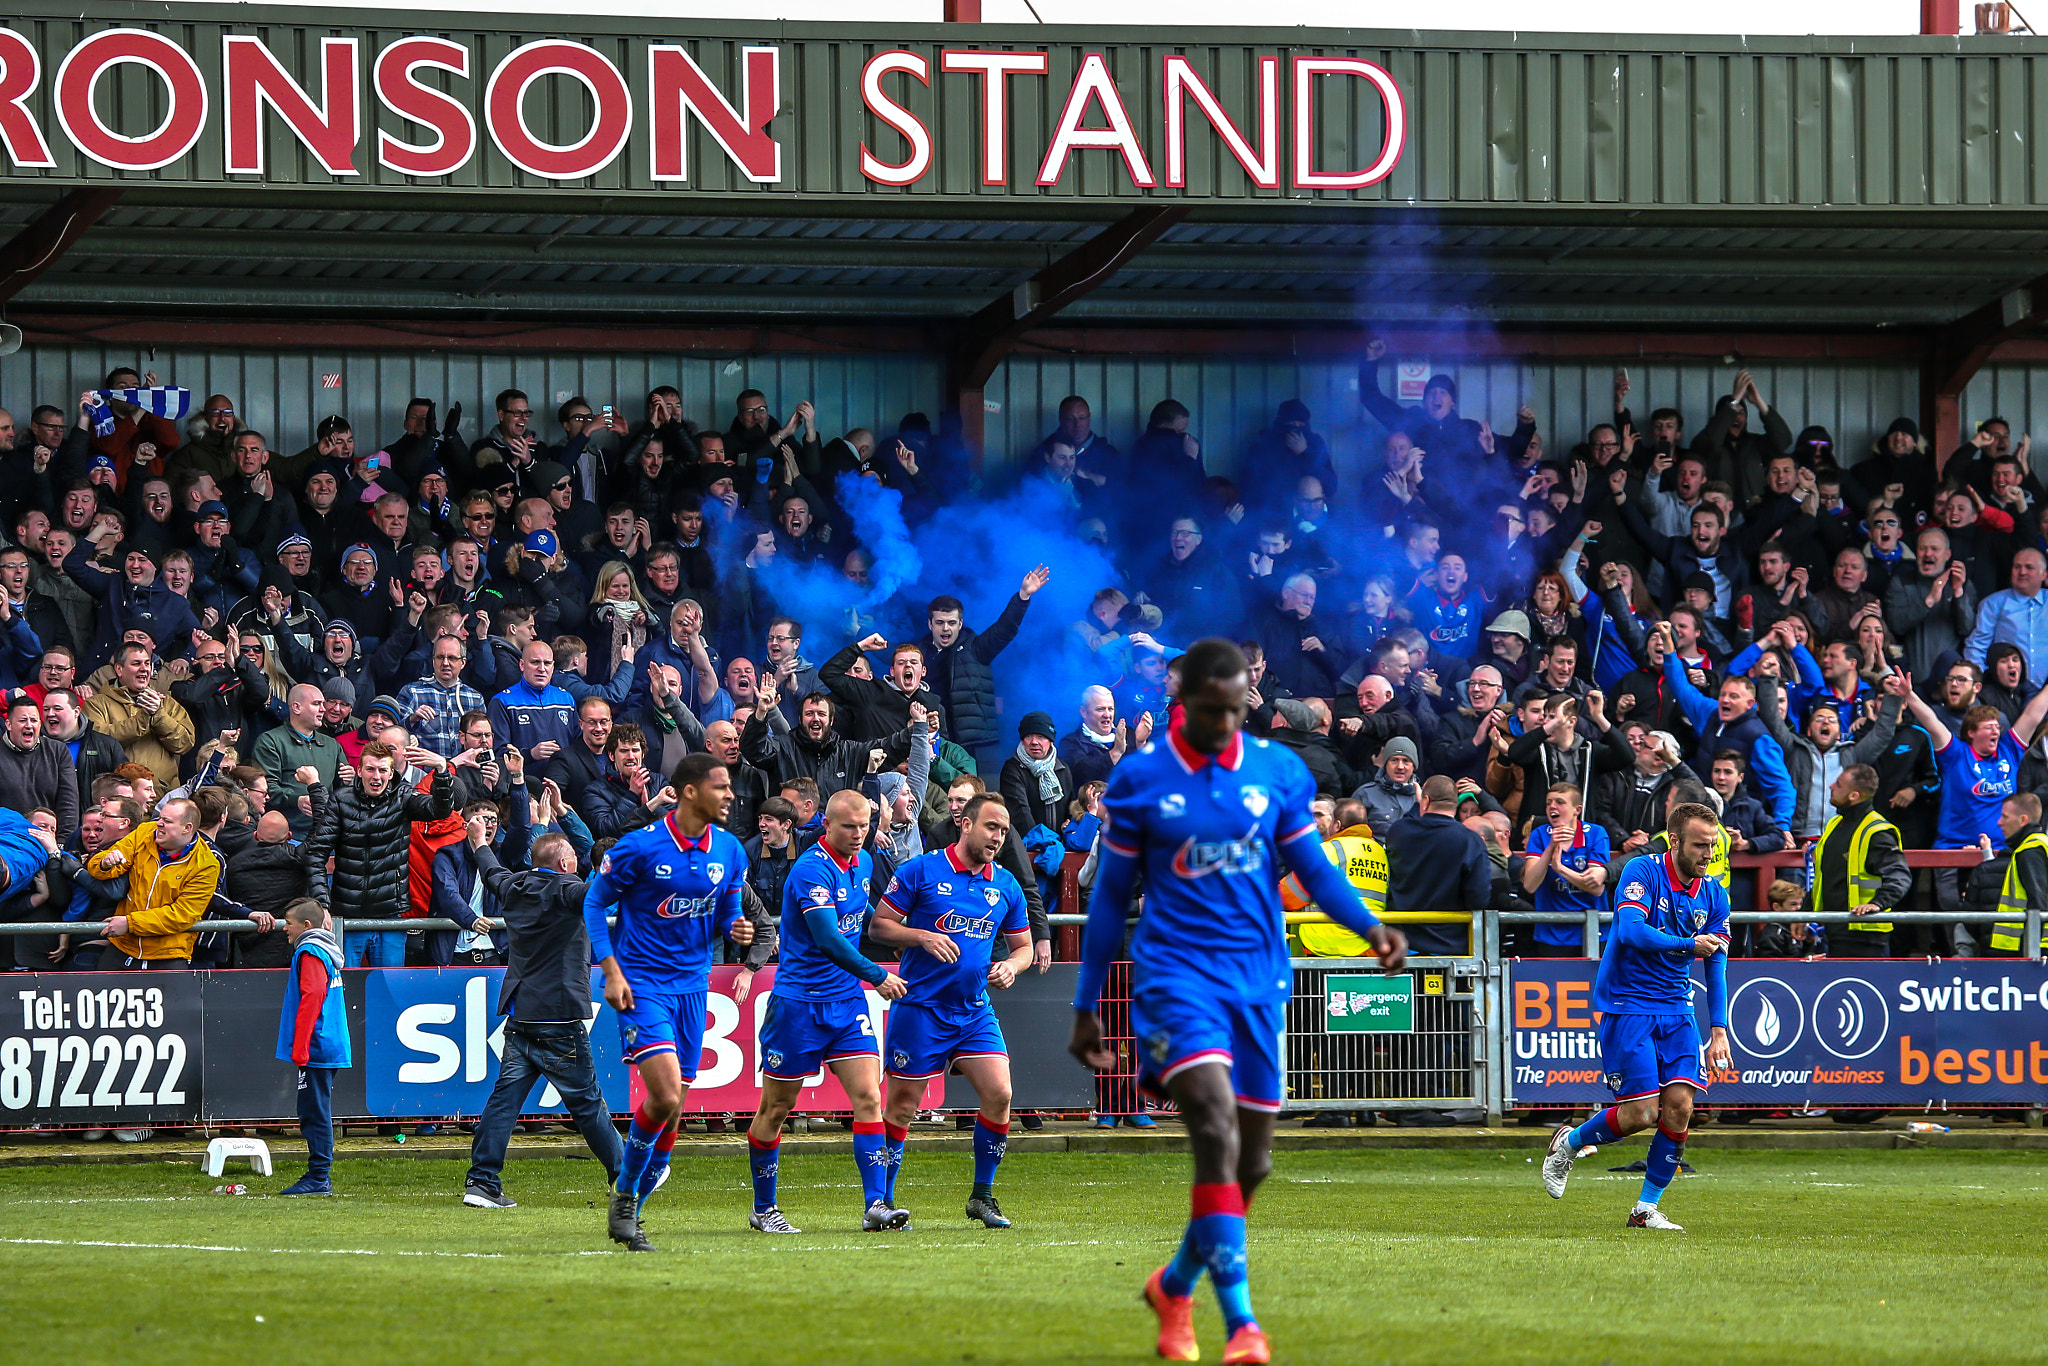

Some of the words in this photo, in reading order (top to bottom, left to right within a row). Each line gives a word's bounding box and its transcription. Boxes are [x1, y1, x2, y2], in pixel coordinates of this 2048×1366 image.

[0, 27, 781, 183] RONSON
[859, 50, 1406, 189] STAND
[1362, 843, 1372, 853] 16
[1349, 867, 1388, 882] STEWARD
[1351, 857, 1386, 872] SAFETY
[948, 914, 995, 936] PFE
[1428, 980, 1440, 989] G3
[19, 989, 71, 1031] Tel:
[76, 987, 164, 1029] 01253
[1369, 1005, 1390, 1016] exit
[1514, 981, 1602, 1028] BE
[855, 1013, 875, 1036] 2
[1515, 1031, 1603, 1059] Utiliti
[0, 1033, 187, 1110] 872222
[1515, 1064, 1545, 1083] The
[1545, 1069, 1602, 1087] power
[1741, 1065, 1775, 1084] and
[1771, 1070, 1812, 1088] your
[1812, 1065, 1885, 1084] business
